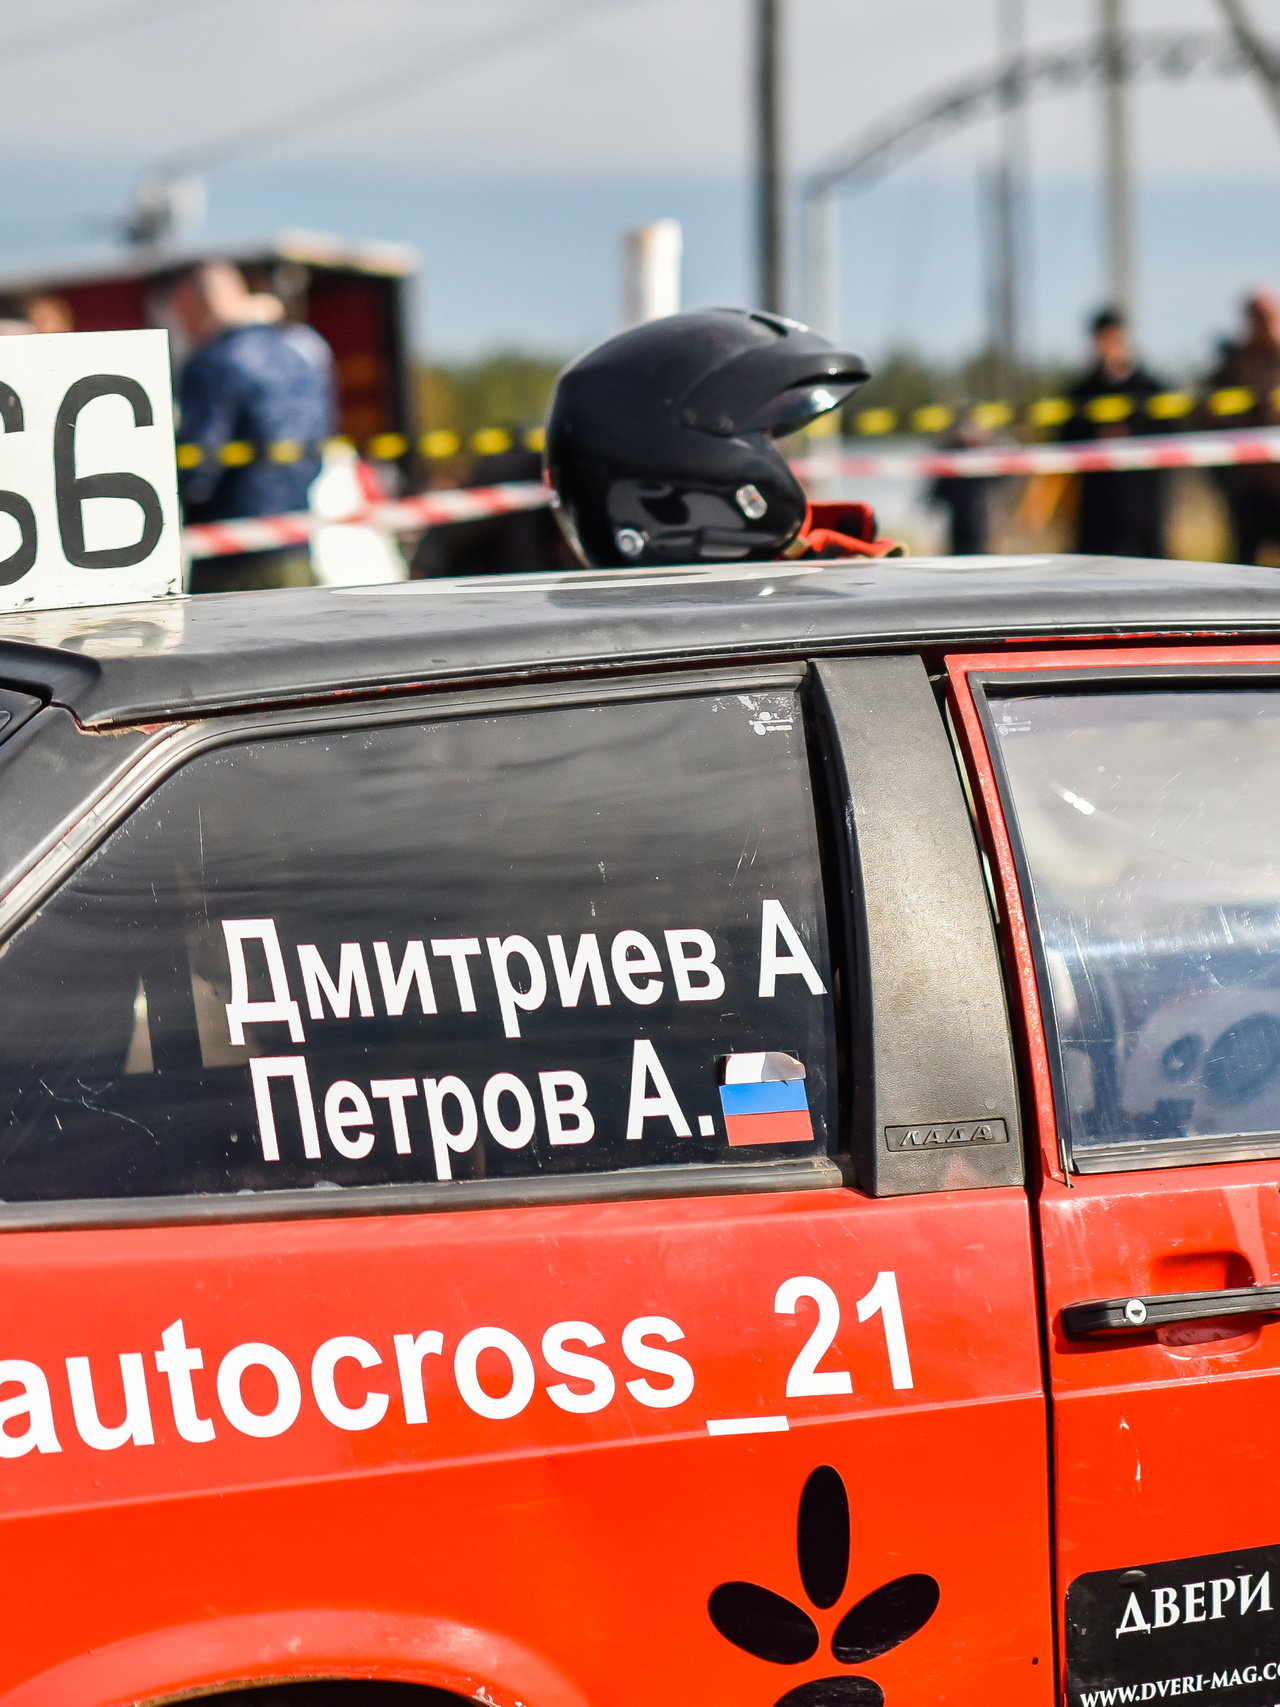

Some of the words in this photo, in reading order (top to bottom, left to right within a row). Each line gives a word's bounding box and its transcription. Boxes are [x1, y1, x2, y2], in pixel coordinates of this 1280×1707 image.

[221, 917, 726, 1045] Дмитриев
[758, 899, 828, 998] А
[249, 1055, 596, 1180] Петров
[626, 1039, 713, 1140] А.
[900, 1124, 993, 1147] ЛАДА
[1116, 1570, 1274, 1639] ДВЕРИ
[1080, 1662, 1280, 1707] WWW.DVERI-MAG.C
